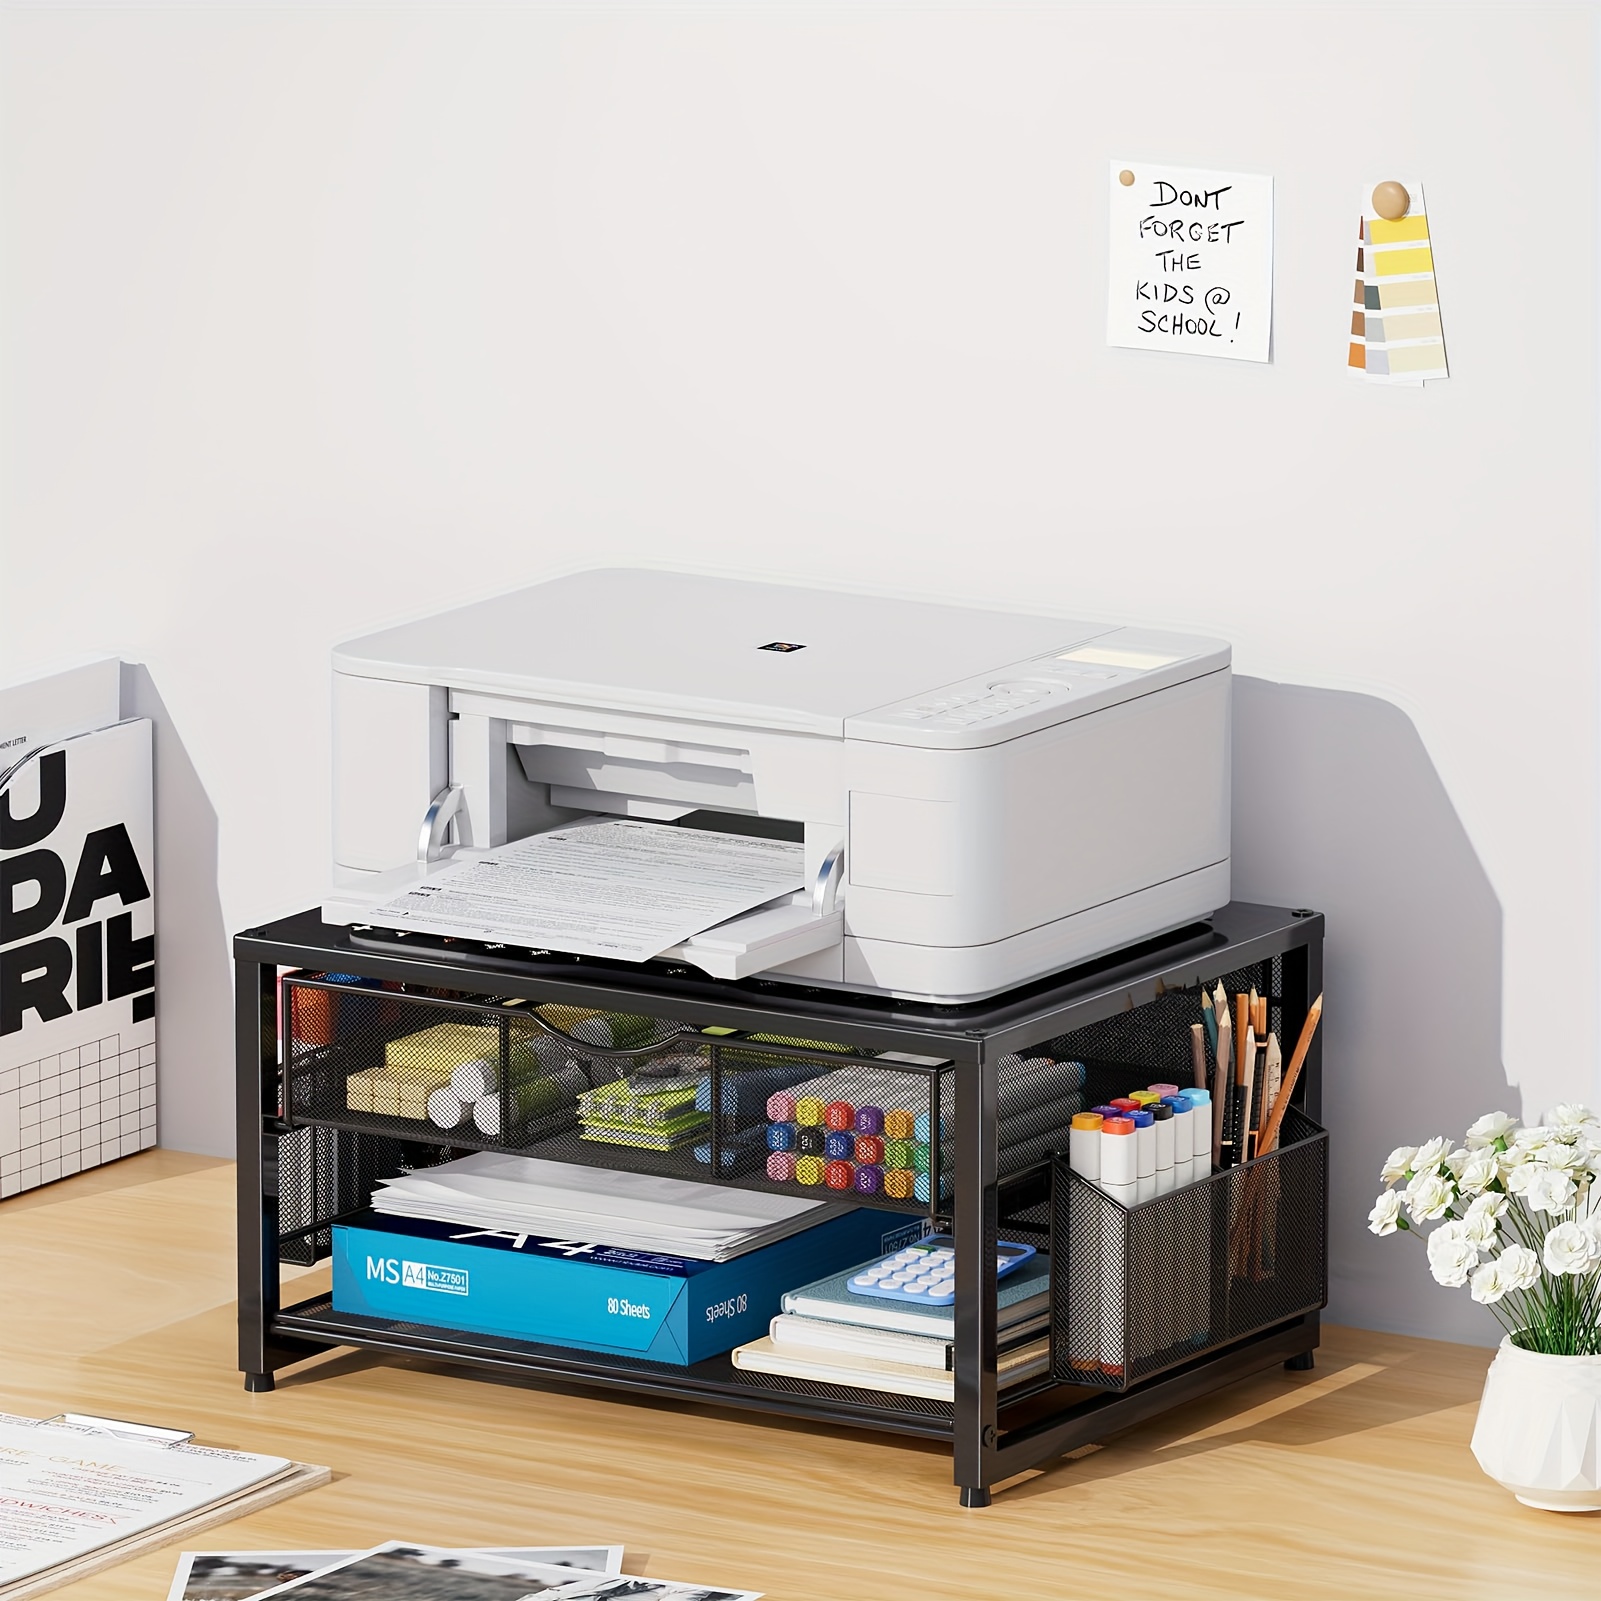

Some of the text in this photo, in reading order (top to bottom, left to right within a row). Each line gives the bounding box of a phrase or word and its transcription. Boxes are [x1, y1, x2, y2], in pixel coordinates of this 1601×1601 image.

[1149, 181, 1233, 211] DONT
[1139, 215, 1245, 244] FORGET
[1155, 249, 1202, 273] THE
[1136, 280, 1231, 315] KIDS @
[366, 1255, 400, 1285] MS
[404, 1264, 425, 1285] A4
[427, 1269, 466, 1286] No.Z7501
[607, 1297, 651, 1320] 80 Sheets
[706, 1293, 748, 1323] 80 Sheets
[0, 1497, 108, 1521] DWICHES
